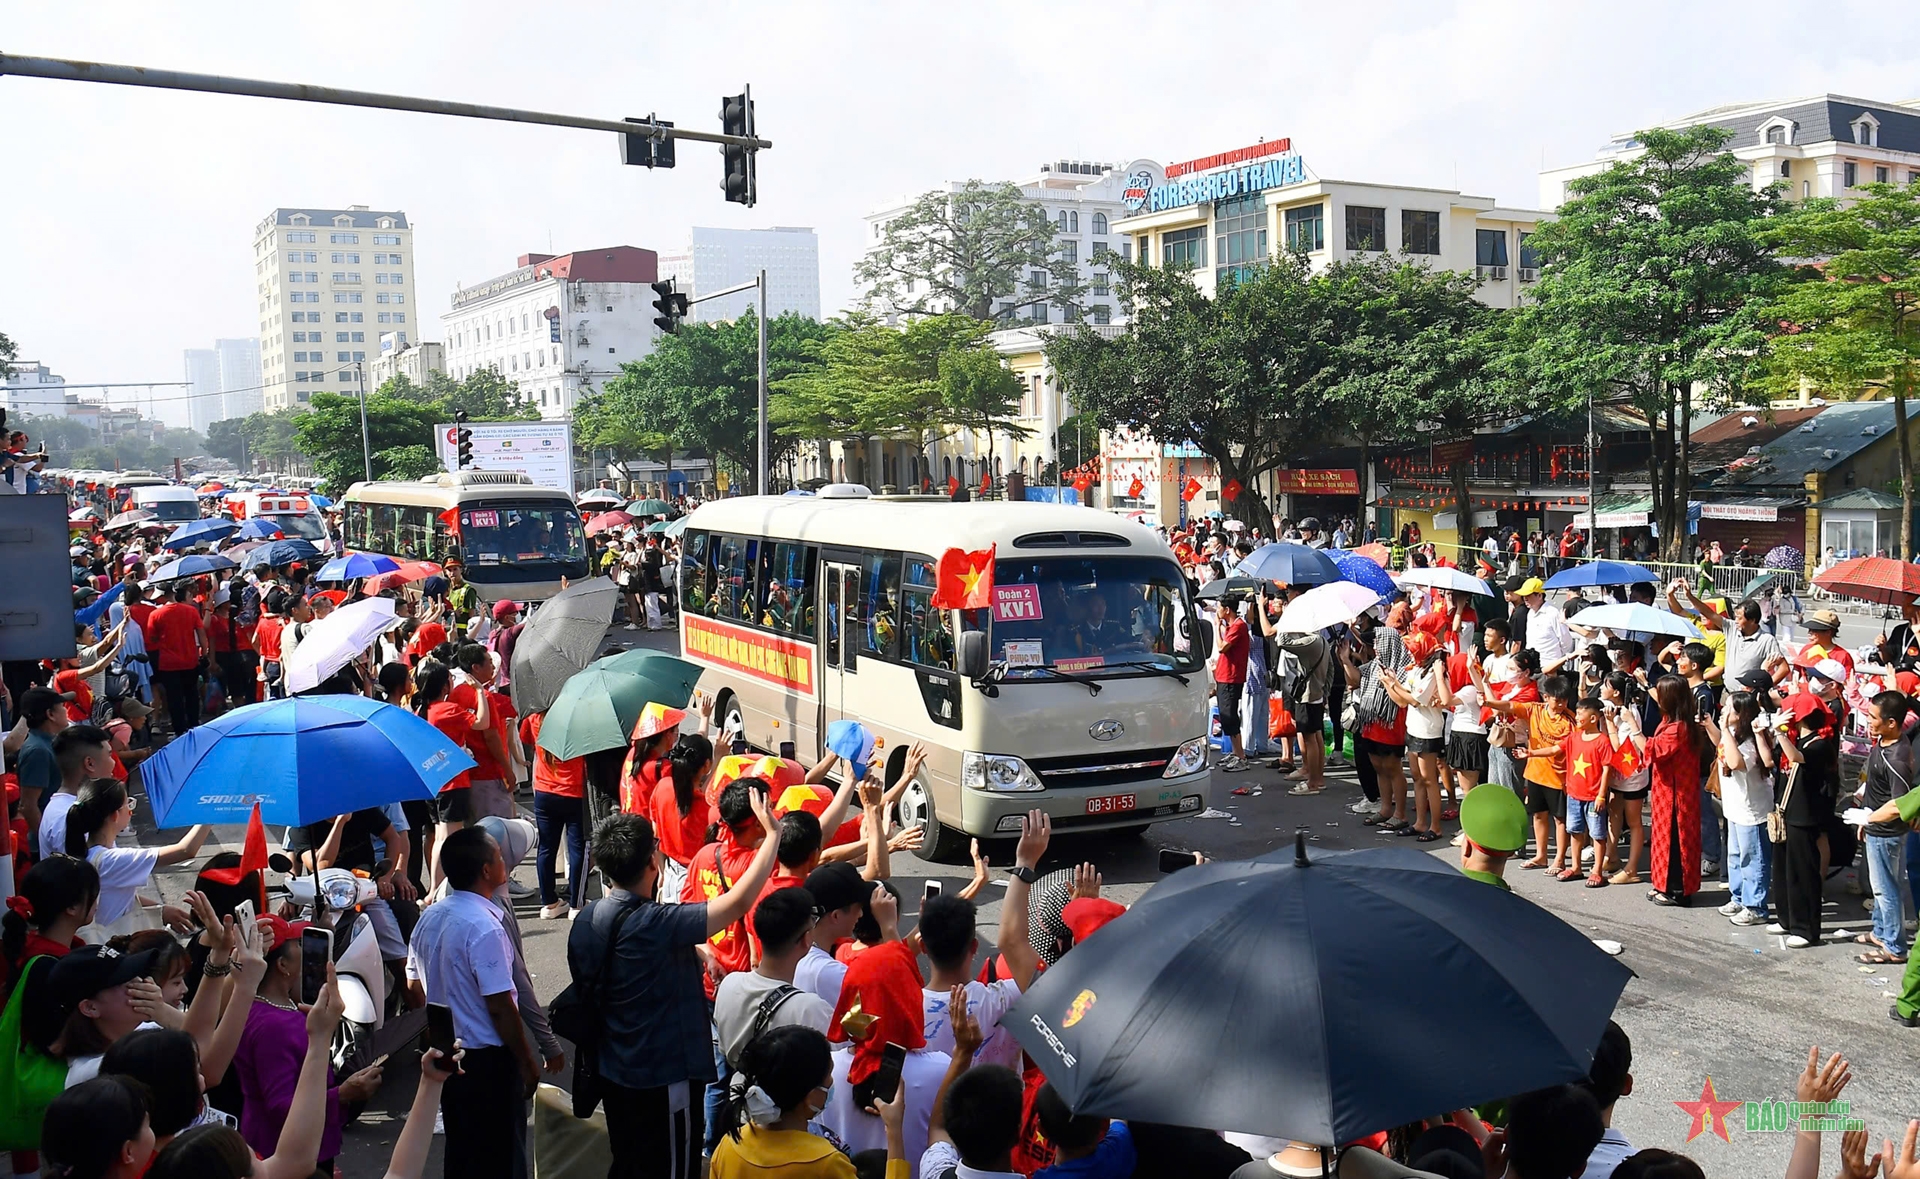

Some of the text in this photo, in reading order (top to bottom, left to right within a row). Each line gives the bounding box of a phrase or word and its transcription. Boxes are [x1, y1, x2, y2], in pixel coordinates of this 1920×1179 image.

[1152, 155, 1306, 212] FORESERCO TRAVEL
[998, 589, 1031, 600] Đoàn 2
[1000, 602, 1035, 618] KV1
[1010, 654, 1040, 664] PHỤC VỤ
[1030, 1014, 1077, 1068] PORSCHE
